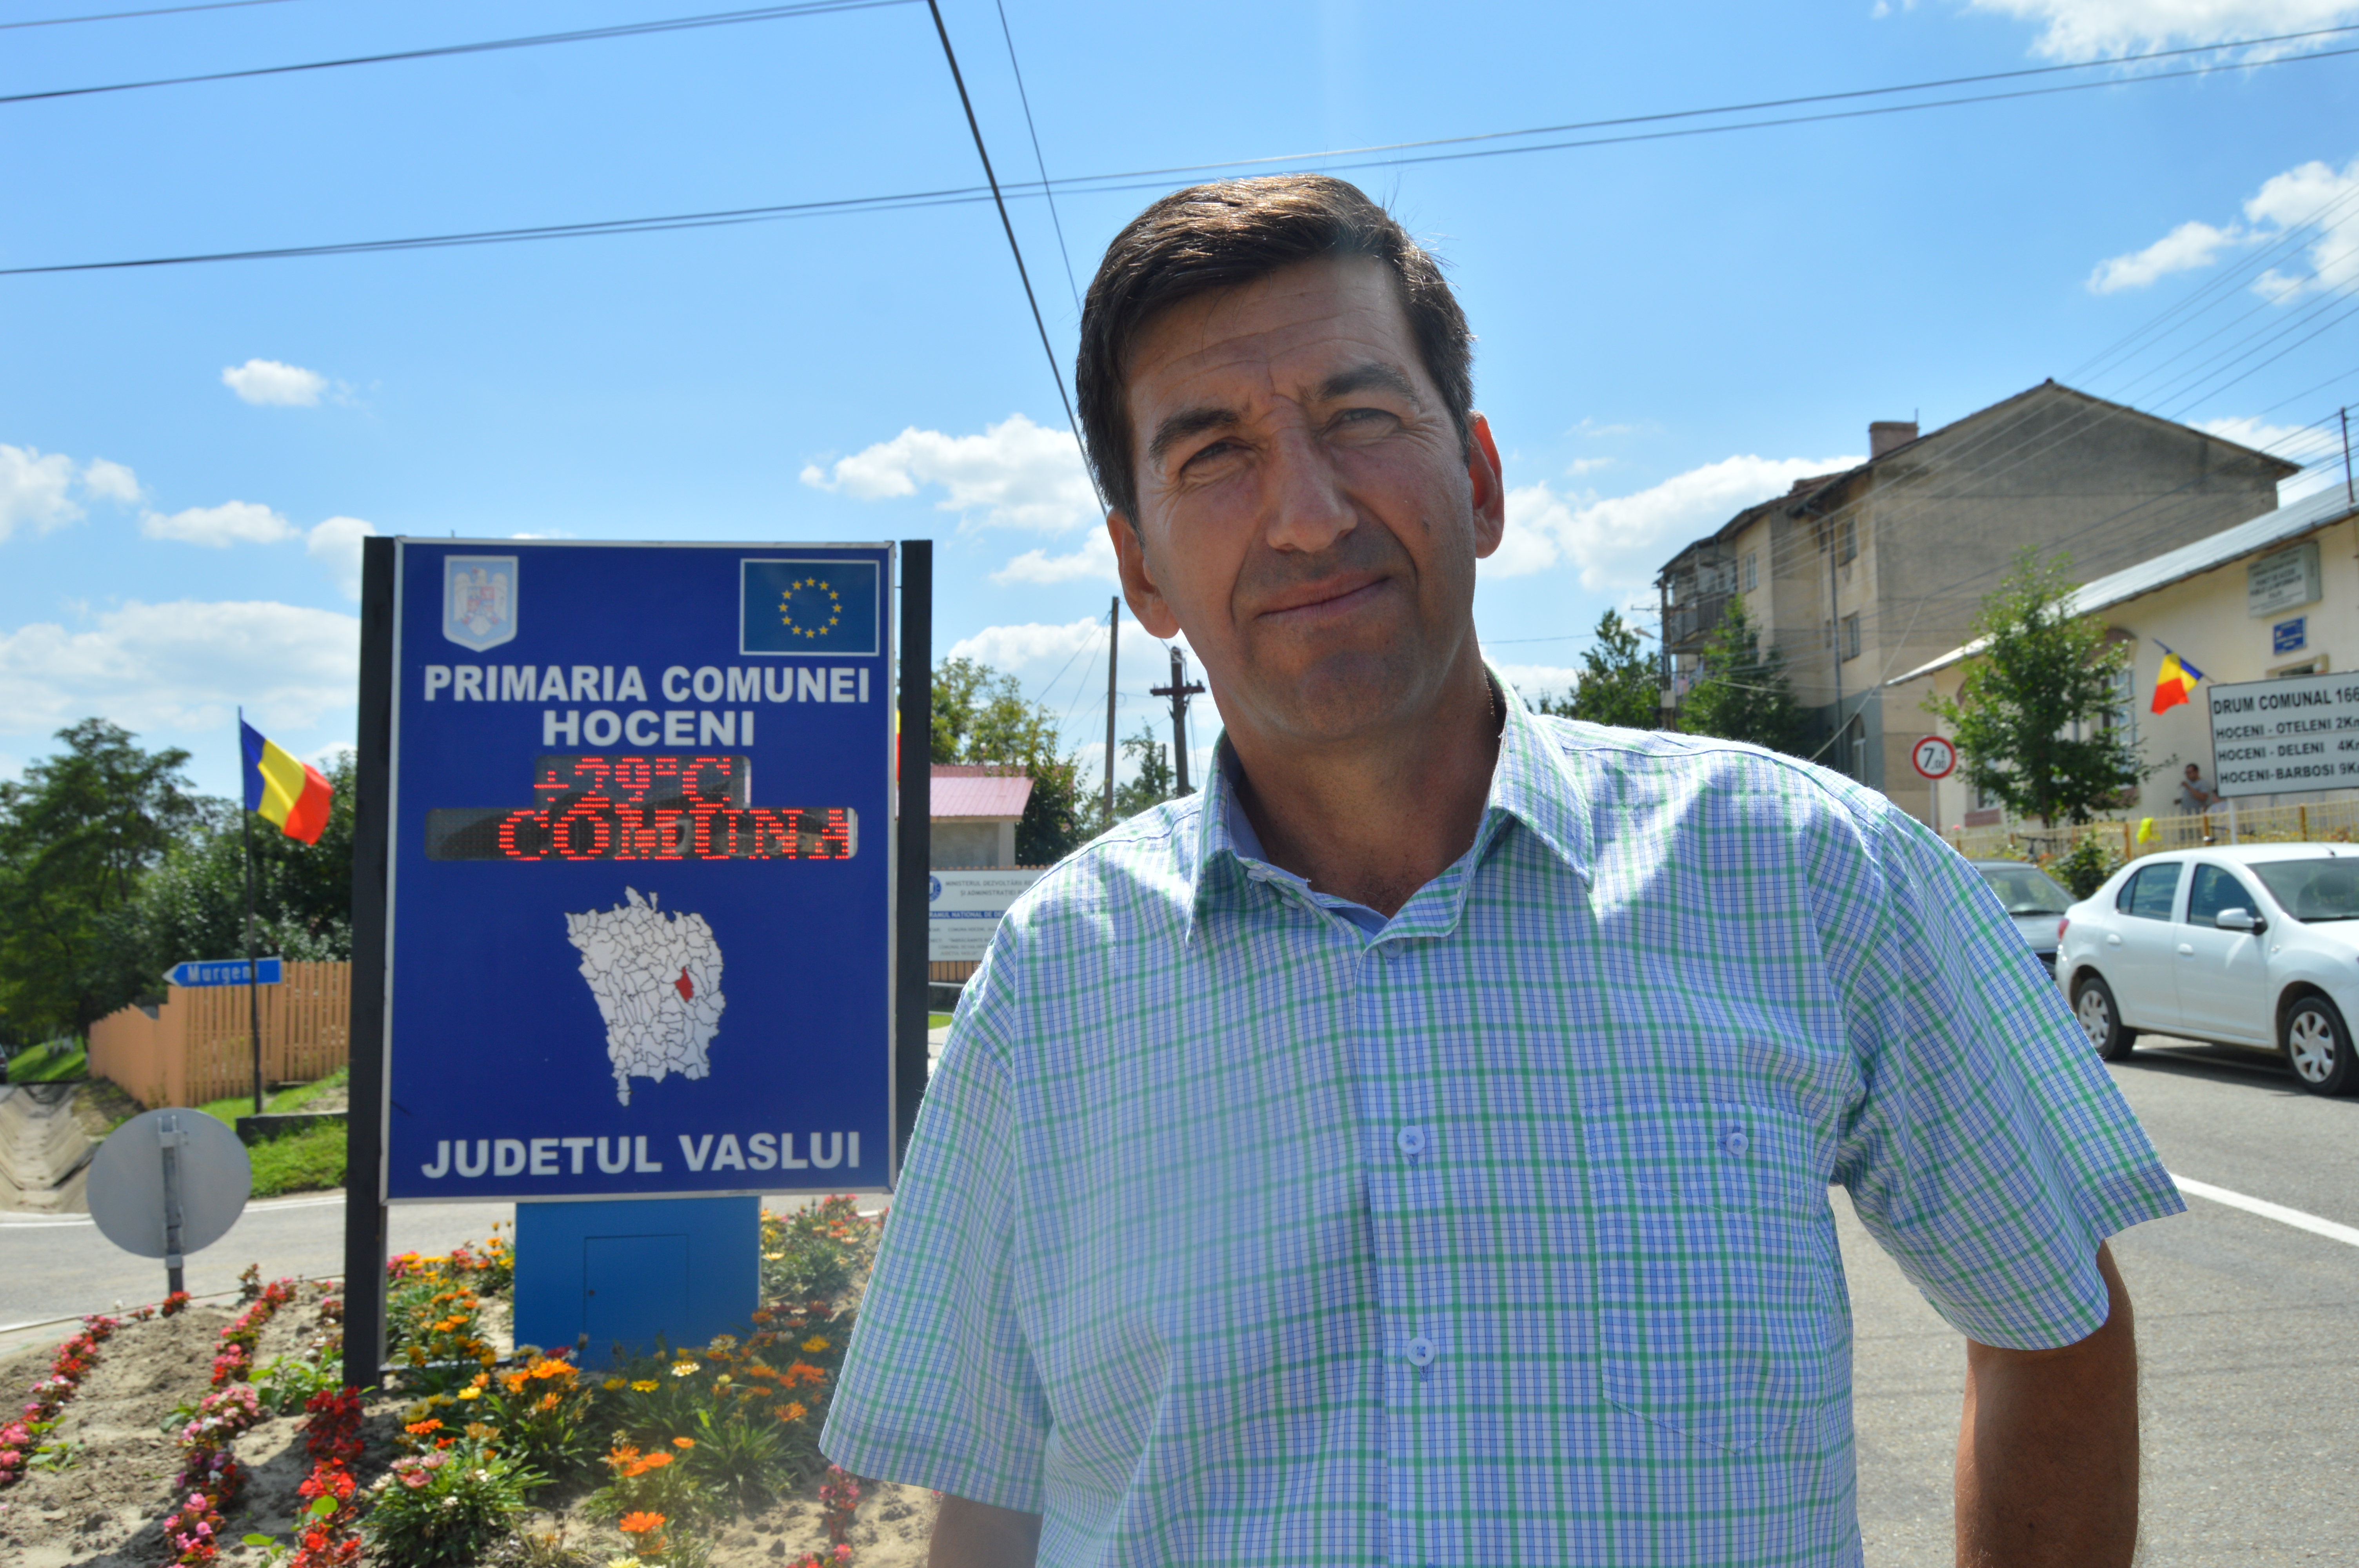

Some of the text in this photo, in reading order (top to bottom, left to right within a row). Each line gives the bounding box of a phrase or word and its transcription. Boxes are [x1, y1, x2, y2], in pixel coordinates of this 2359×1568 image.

[424, 665, 869, 703] PRIMARIA COMUNEI
[2214, 696, 2254, 714] DRUM
[2259, 689, 2332, 710] COMUNAL
[543, 709, 754, 747] HOCENI
[2216, 725, 2264, 739] HOCENI
[2277, 719, 2332, 734] OTELENI
[2218, 747, 2266, 761] HOCENI
[2278, 742, 2324, 757] DELENI
[422, 1131, 860, 1178] JUDETUL VASLUI
